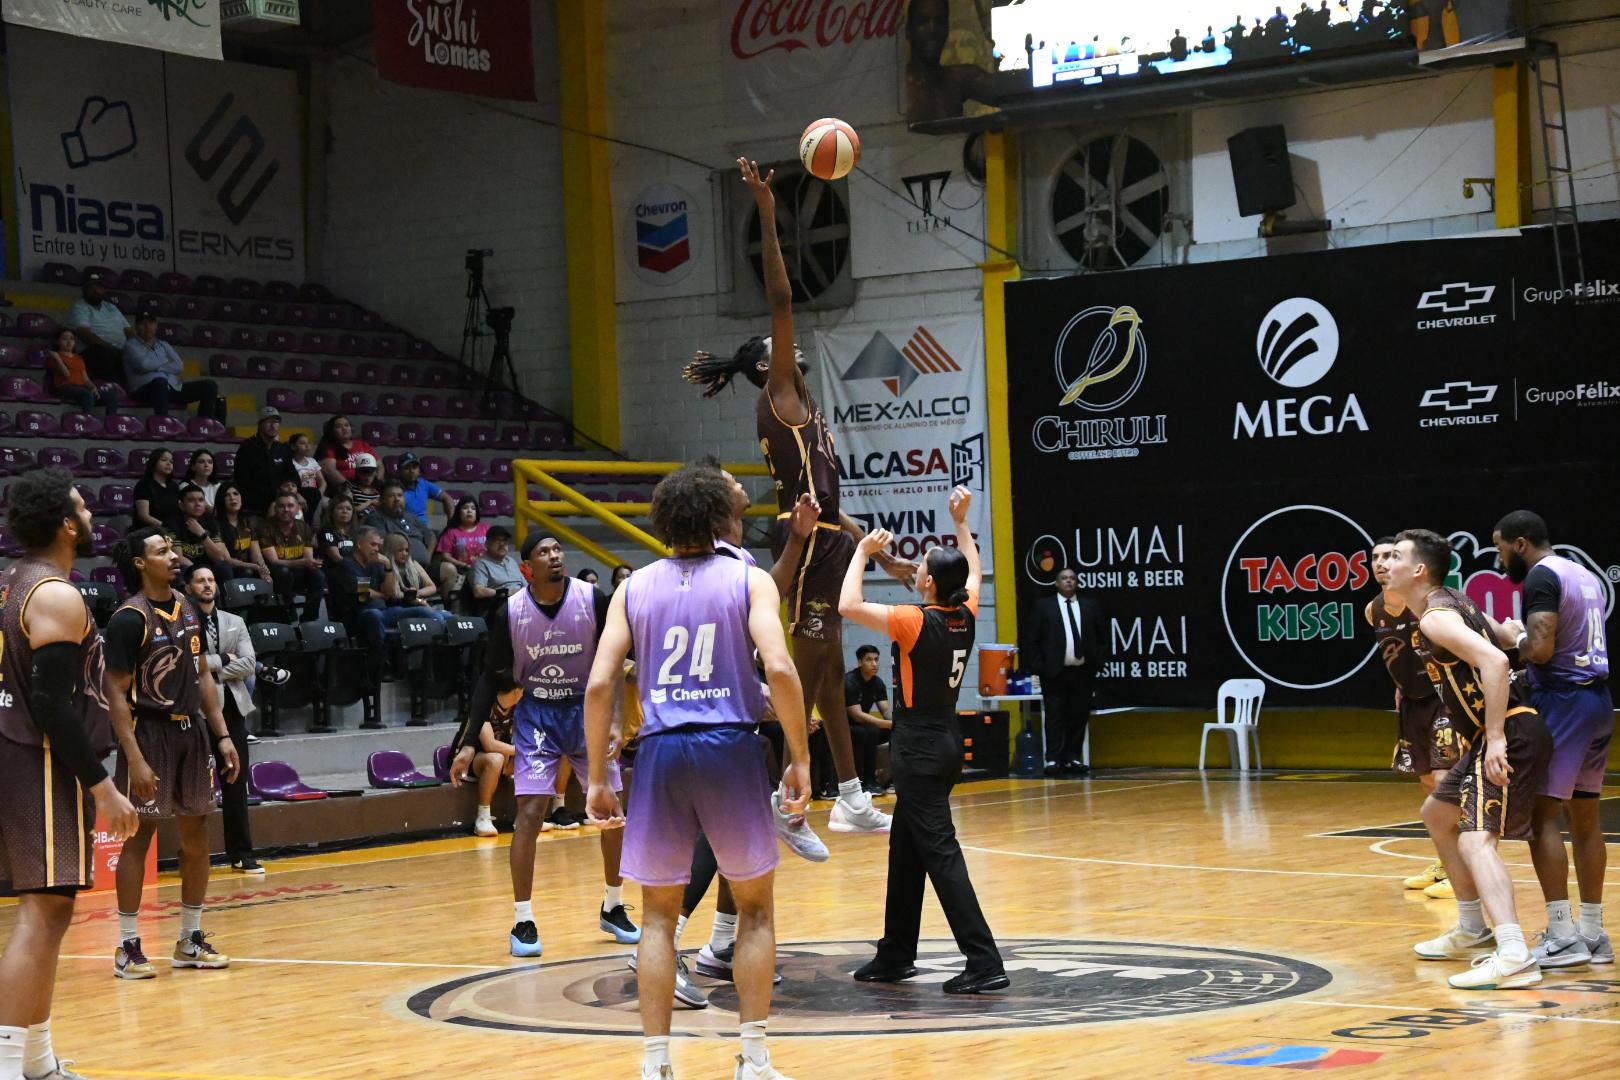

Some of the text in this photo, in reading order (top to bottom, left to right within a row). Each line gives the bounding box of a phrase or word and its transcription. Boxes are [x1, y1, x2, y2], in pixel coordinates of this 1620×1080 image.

[112, 3, 142, 17] CARE
[407, 0, 480, 46] Sushi
[731, 0, 815, 59] Coca
[424, 33, 491, 72] Lomas
[30, 183, 165, 241] niasa
[635, 200, 687, 218] Chevron
[906, 216, 951, 232] TITAN
[33, 235, 165, 262] Entre tú y tu obra
[178, 230, 294, 260] ERMES
[1417, 315, 1496, 329] CHEVROLET
[834, 396, 970, 423] MEX-ALCO
[1233, 393, 1369, 440] MEGA
[1420, 414, 1499, 427] CHEVROLET
[1033, 415, 1167, 452] CHIRULI
[836, 448, 949, 480] ALCASA
[893, 486, 923, 495] HAZLO
[927, 485, 948, 493] BIEN
[878, 510, 935, 534] WIN
[1076, 525, 1183, 566] UMAI
[1077, 570, 1184, 589] SUSHI & BEER
[1240, 551, 1370, 593] TACOS
[802, 627, 825, 640] MEGA
[1258, 602, 1354, 641] KISSI
[1112, 616, 1187, 655] MAI
[526, 643, 583, 660] VENADOS
[657, 623, 716, 685] 24
[551, 673, 580, 685] Azteca
[949, 649, 967, 688] 5
[1130, 662, 1142, 679] &
[1148, 661, 1187, 678] BEER
[672, 685, 731, 702] Chevron
[136, 805, 160, 815] MEGA
